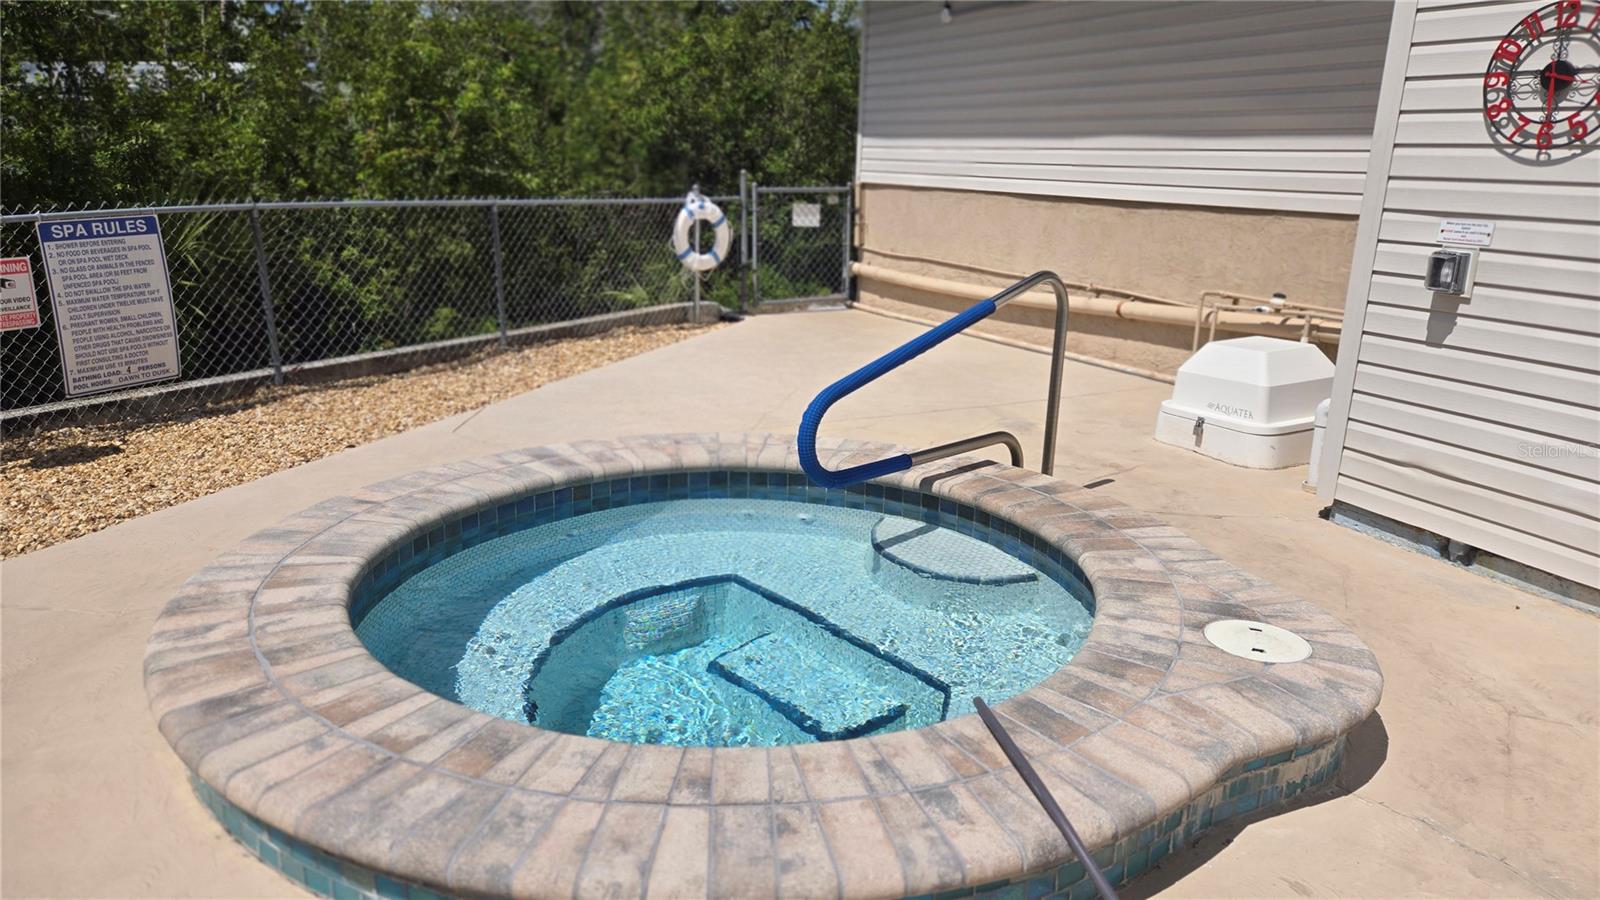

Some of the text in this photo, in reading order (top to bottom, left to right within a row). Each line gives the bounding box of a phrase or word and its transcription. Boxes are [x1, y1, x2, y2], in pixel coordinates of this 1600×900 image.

[1555, 0, 1582, 28] 12
[1521, 12, 1544, 40] 11
[1494, 38, 1522, 63] 10
[1485, 72, 1510, 88] 9
[1488, 97, 1512, 121] 8
[1507, 113, 1531, 141] 7
[1568, 112, 1588, 140] 5
[1537, 121, 1554, 149] 6
[51, 220, 147, 238] SPA RULES
[63, 281, 92, 290] UNFENCED
[111, 291, 146, 300] TEMPERATURE
[87, 309, 121, 318] SUPERVISION
[70, 320, 98, 329] PREGNANT
[127, 320, 152, 328] PROBLEMS
[136, 326, 163, 335] NARCOTICS
[77, 365, 104, 374] MAXIMUM
[124, 358, 148, 366] MINUTES
[92, 354, 124, 364] CONSULTING
[72, 374, 101, 383] BATHING
[138, 363, 166, 372] PERSONS
[119, 374, 140, 382] DAWN
